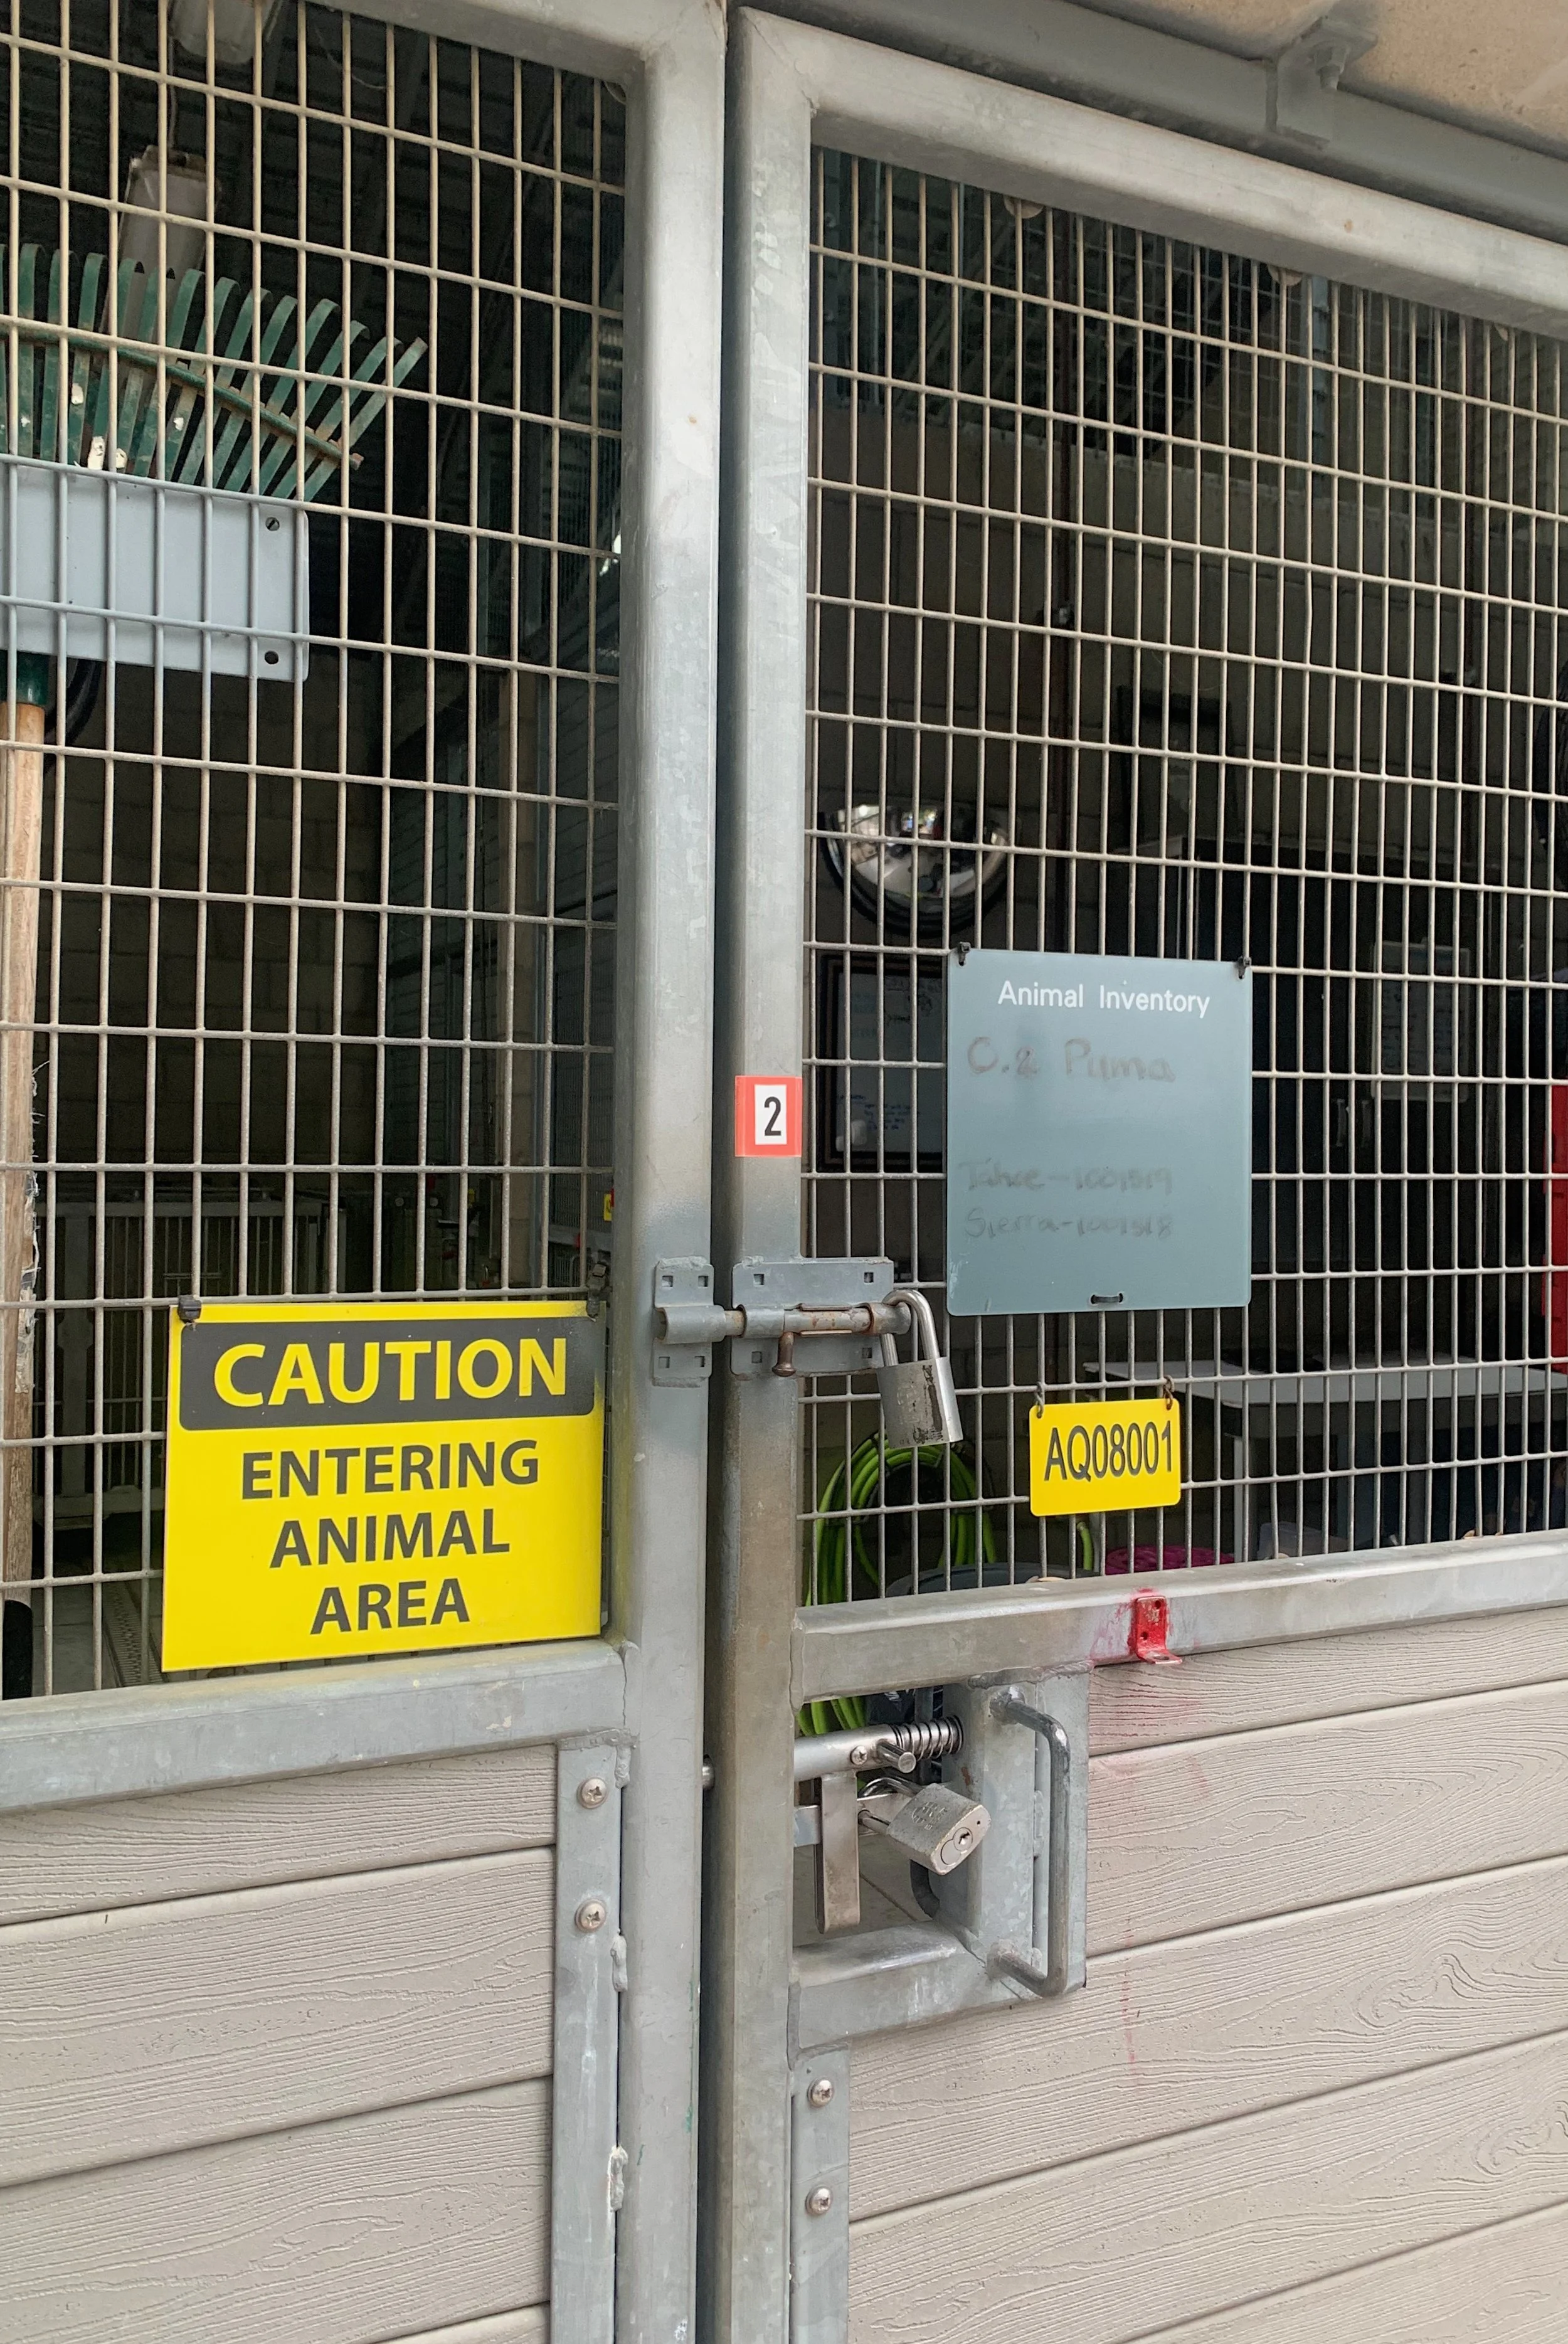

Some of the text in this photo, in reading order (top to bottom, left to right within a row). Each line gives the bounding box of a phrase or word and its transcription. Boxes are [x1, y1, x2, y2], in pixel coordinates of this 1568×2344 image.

[998, 980, 1210, 1019] Animal Inventory
[1064, 1037, 1177, 1083] Puma
[764, 1096, 781, 1136] 2
[213, 1337, 567, 1408] CAUTION
[241, 1440, 539, 1500] ENTERING
[1043, 1420, 1173, 1482] AQ08001
[269, 1509, 511, 1569] ANIMAL
[310, 1578, 471, 1635] AREA
